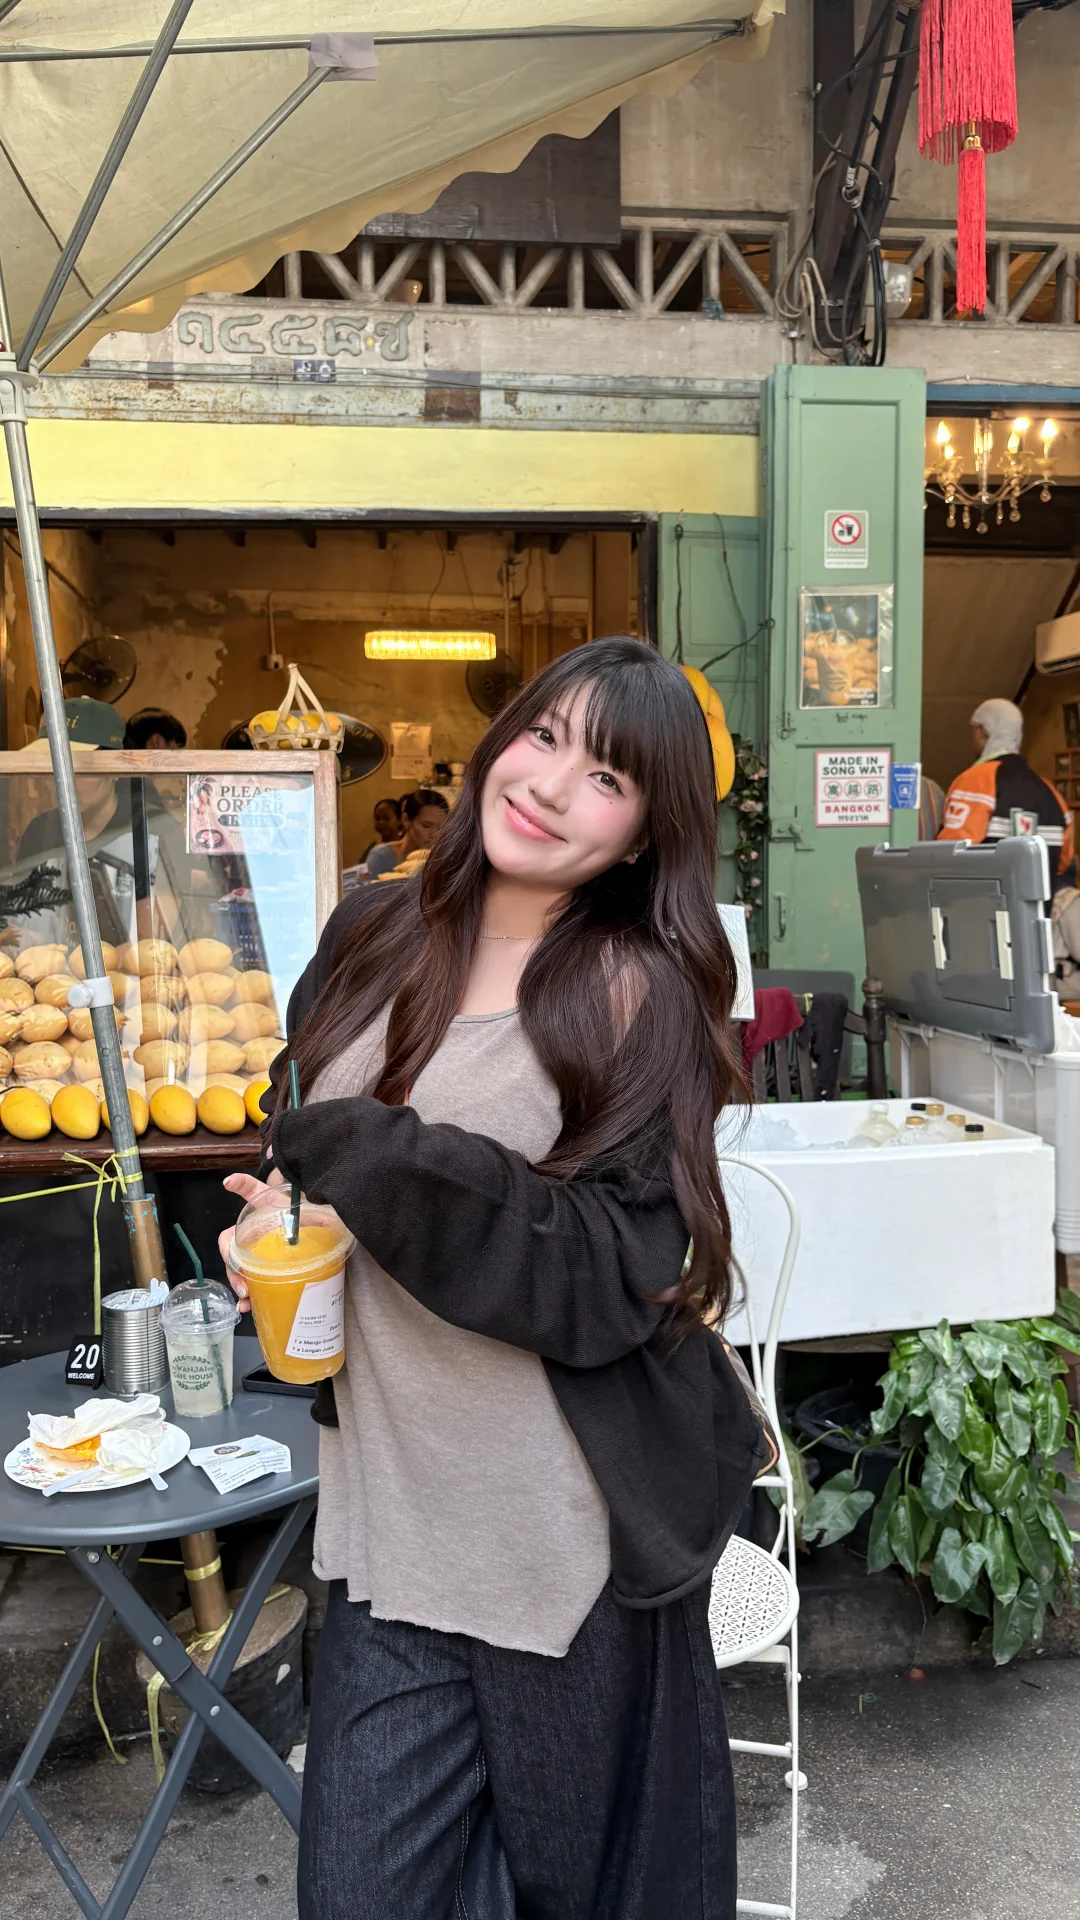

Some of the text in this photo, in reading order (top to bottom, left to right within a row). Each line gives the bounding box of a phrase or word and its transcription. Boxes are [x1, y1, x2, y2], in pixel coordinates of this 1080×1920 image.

[829, 756, 878, 766] MADE IN
[822, 766, 856, 776] SONG
[859, 766, 884, 775] WAT
[220, 785, 282, 801] PLEASE
[216, 798, 284, 814] ORDER
[824, 804, 881, 814] BANGKOK
[70, 1343, 101, 1370] 20
[67, 1372, 96, 1380] WELCOME
